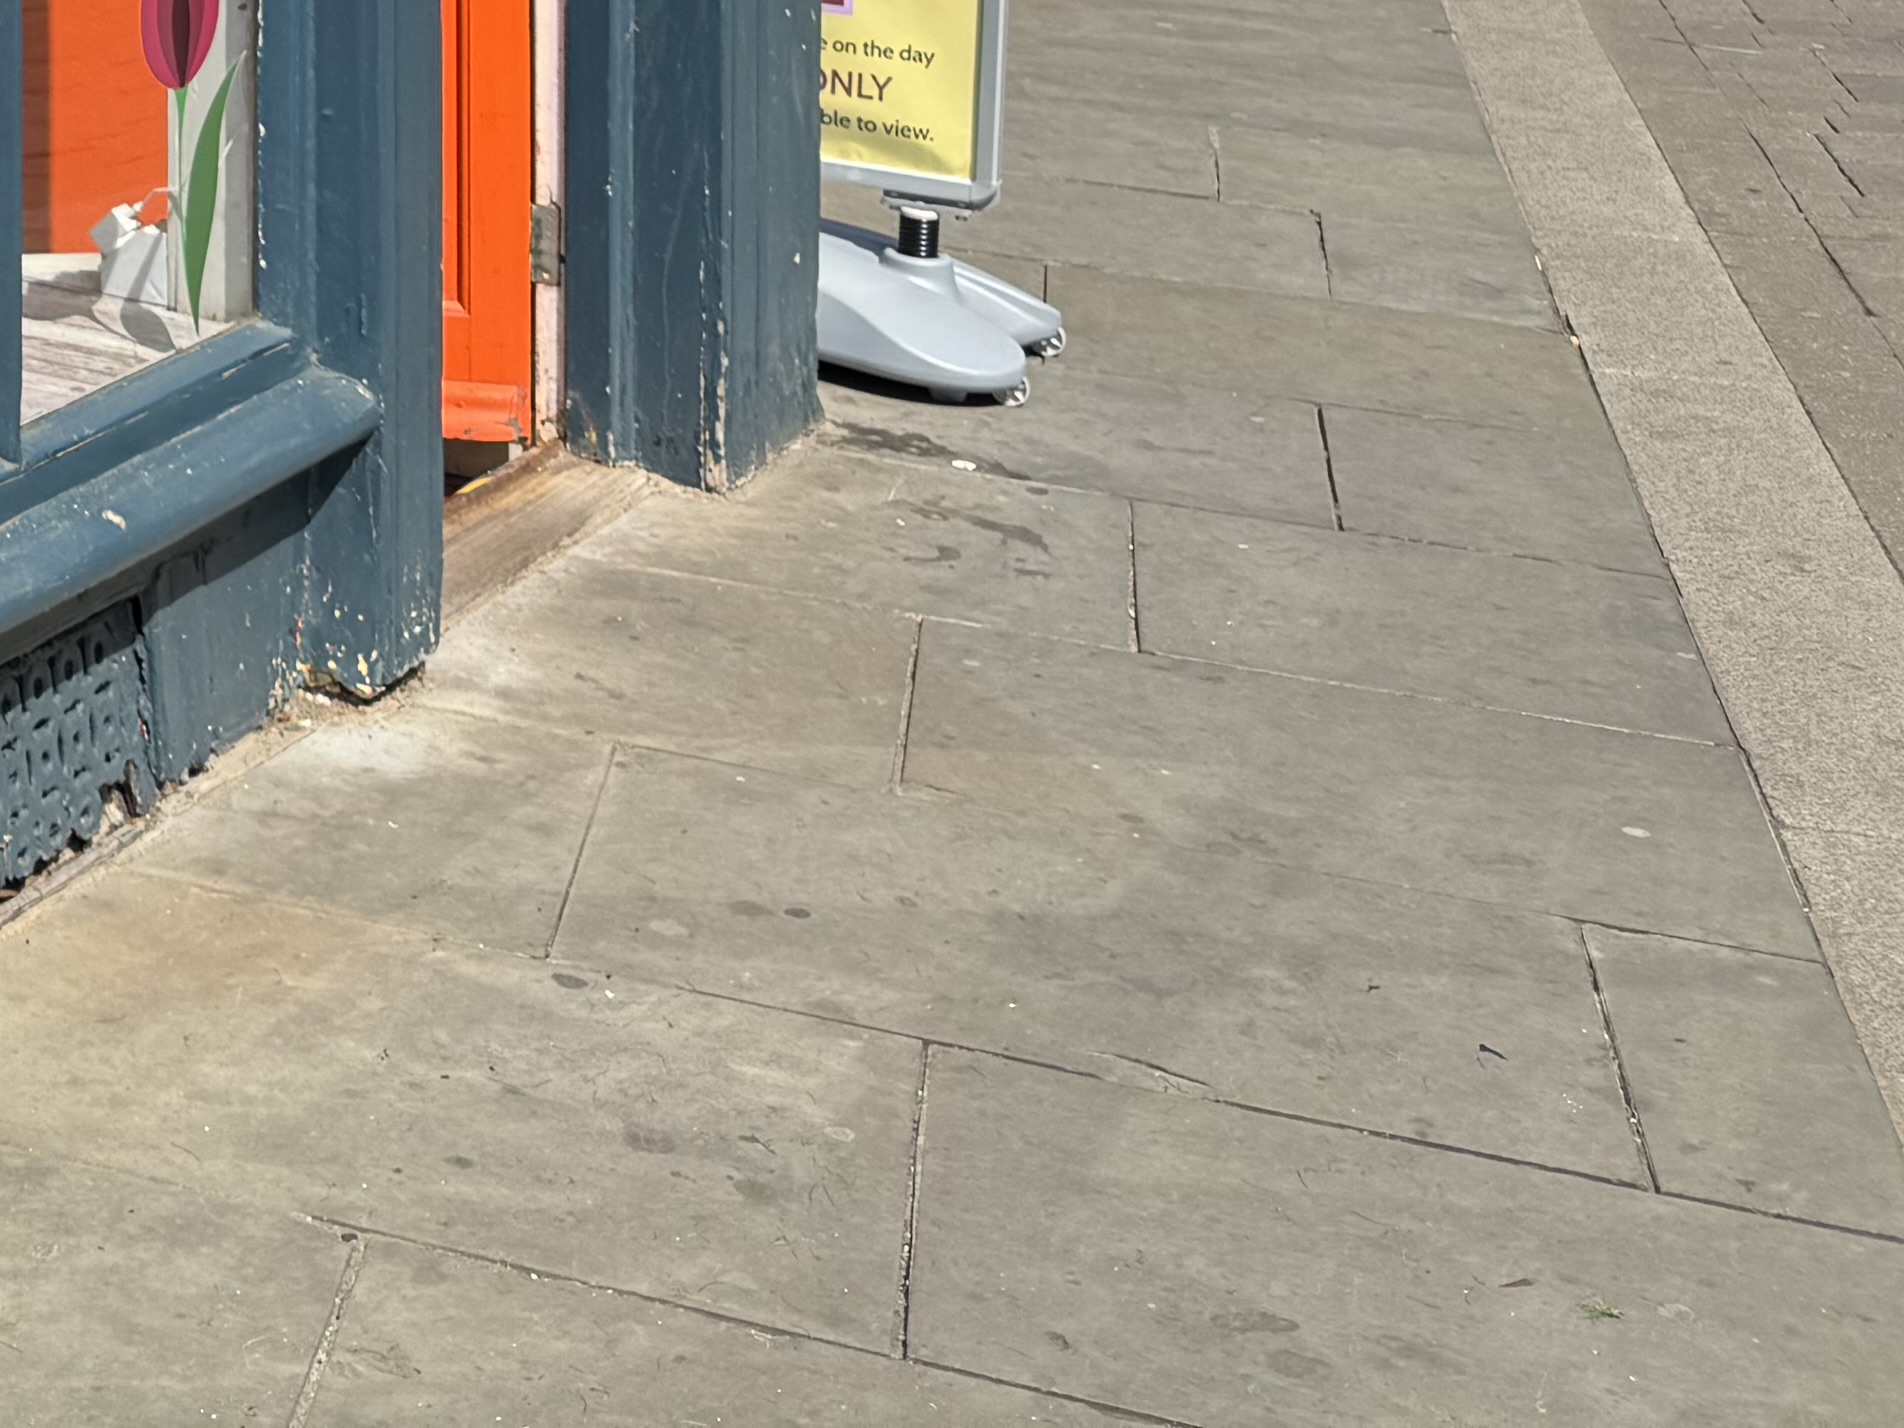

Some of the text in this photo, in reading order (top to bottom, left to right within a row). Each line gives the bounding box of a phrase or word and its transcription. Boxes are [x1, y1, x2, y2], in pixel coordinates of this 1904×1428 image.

[832, 38, 857, 56] on
[863, 39, 894, 60] the
[899, 44, 936, 70] day
[856, 114, 878, 133] to
[882, 117, 935, 143] view.
